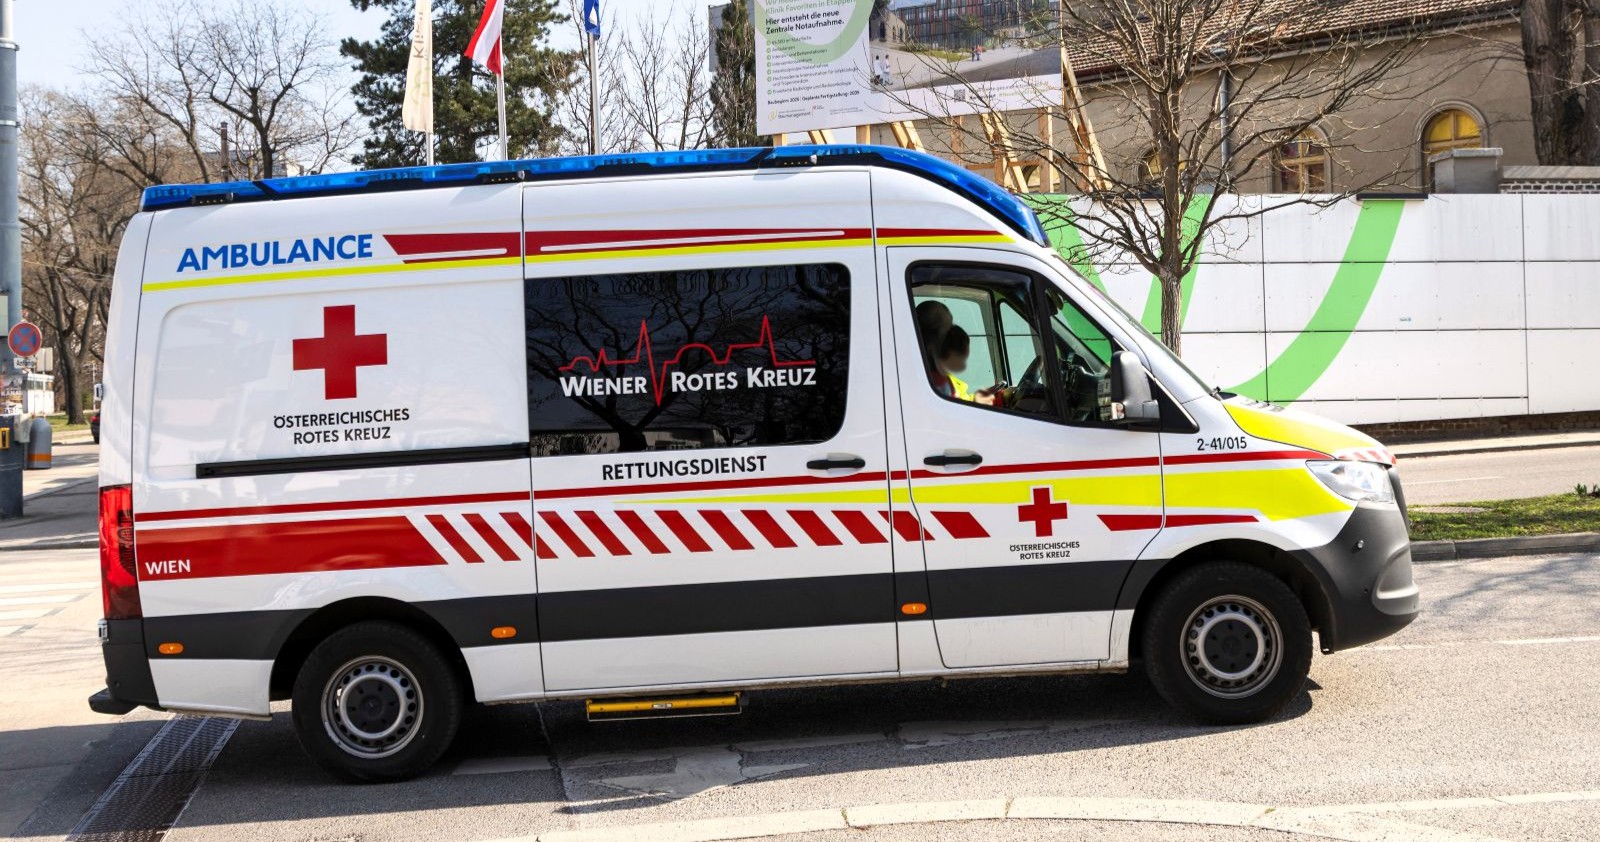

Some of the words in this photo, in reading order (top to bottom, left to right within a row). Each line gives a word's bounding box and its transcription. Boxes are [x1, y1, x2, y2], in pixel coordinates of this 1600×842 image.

[766, 6, 784, 14] Klinik
[786, 2, 817, 12] Favoriten
[818, 0, 826, 8] in
[781, 14, 809, 23] entsteht
[810, 11, 821, 19] die
[766, 25, 794, 34] Zentrale
[795, 18, 844, 30] Notaufnahme.
[176, 233, 373, 272] AMBULANCE
[559, 375, 648, 397] WIENER
[671, 371, 738, 393] ROTES
[747, 367, 817, 388] KREUZ
[273, 408, 410, 429] ÖSTERREICHISCHES
[293, 430, 339, 445] ROTES
[344, 427, 391, 442] KREUZ
[1197, 436, 1247, 451] 2-41/015
[602, 455, 767, 480] RETTUNGSDIENST
[1009, 541, 1080, 552] ÖSTERREICHISCHES
[1019, 552, 1044, 560] ROTES
[1046, 550, 1071, 559] KREUZ
[145, 559, 191, 575] WIEN
